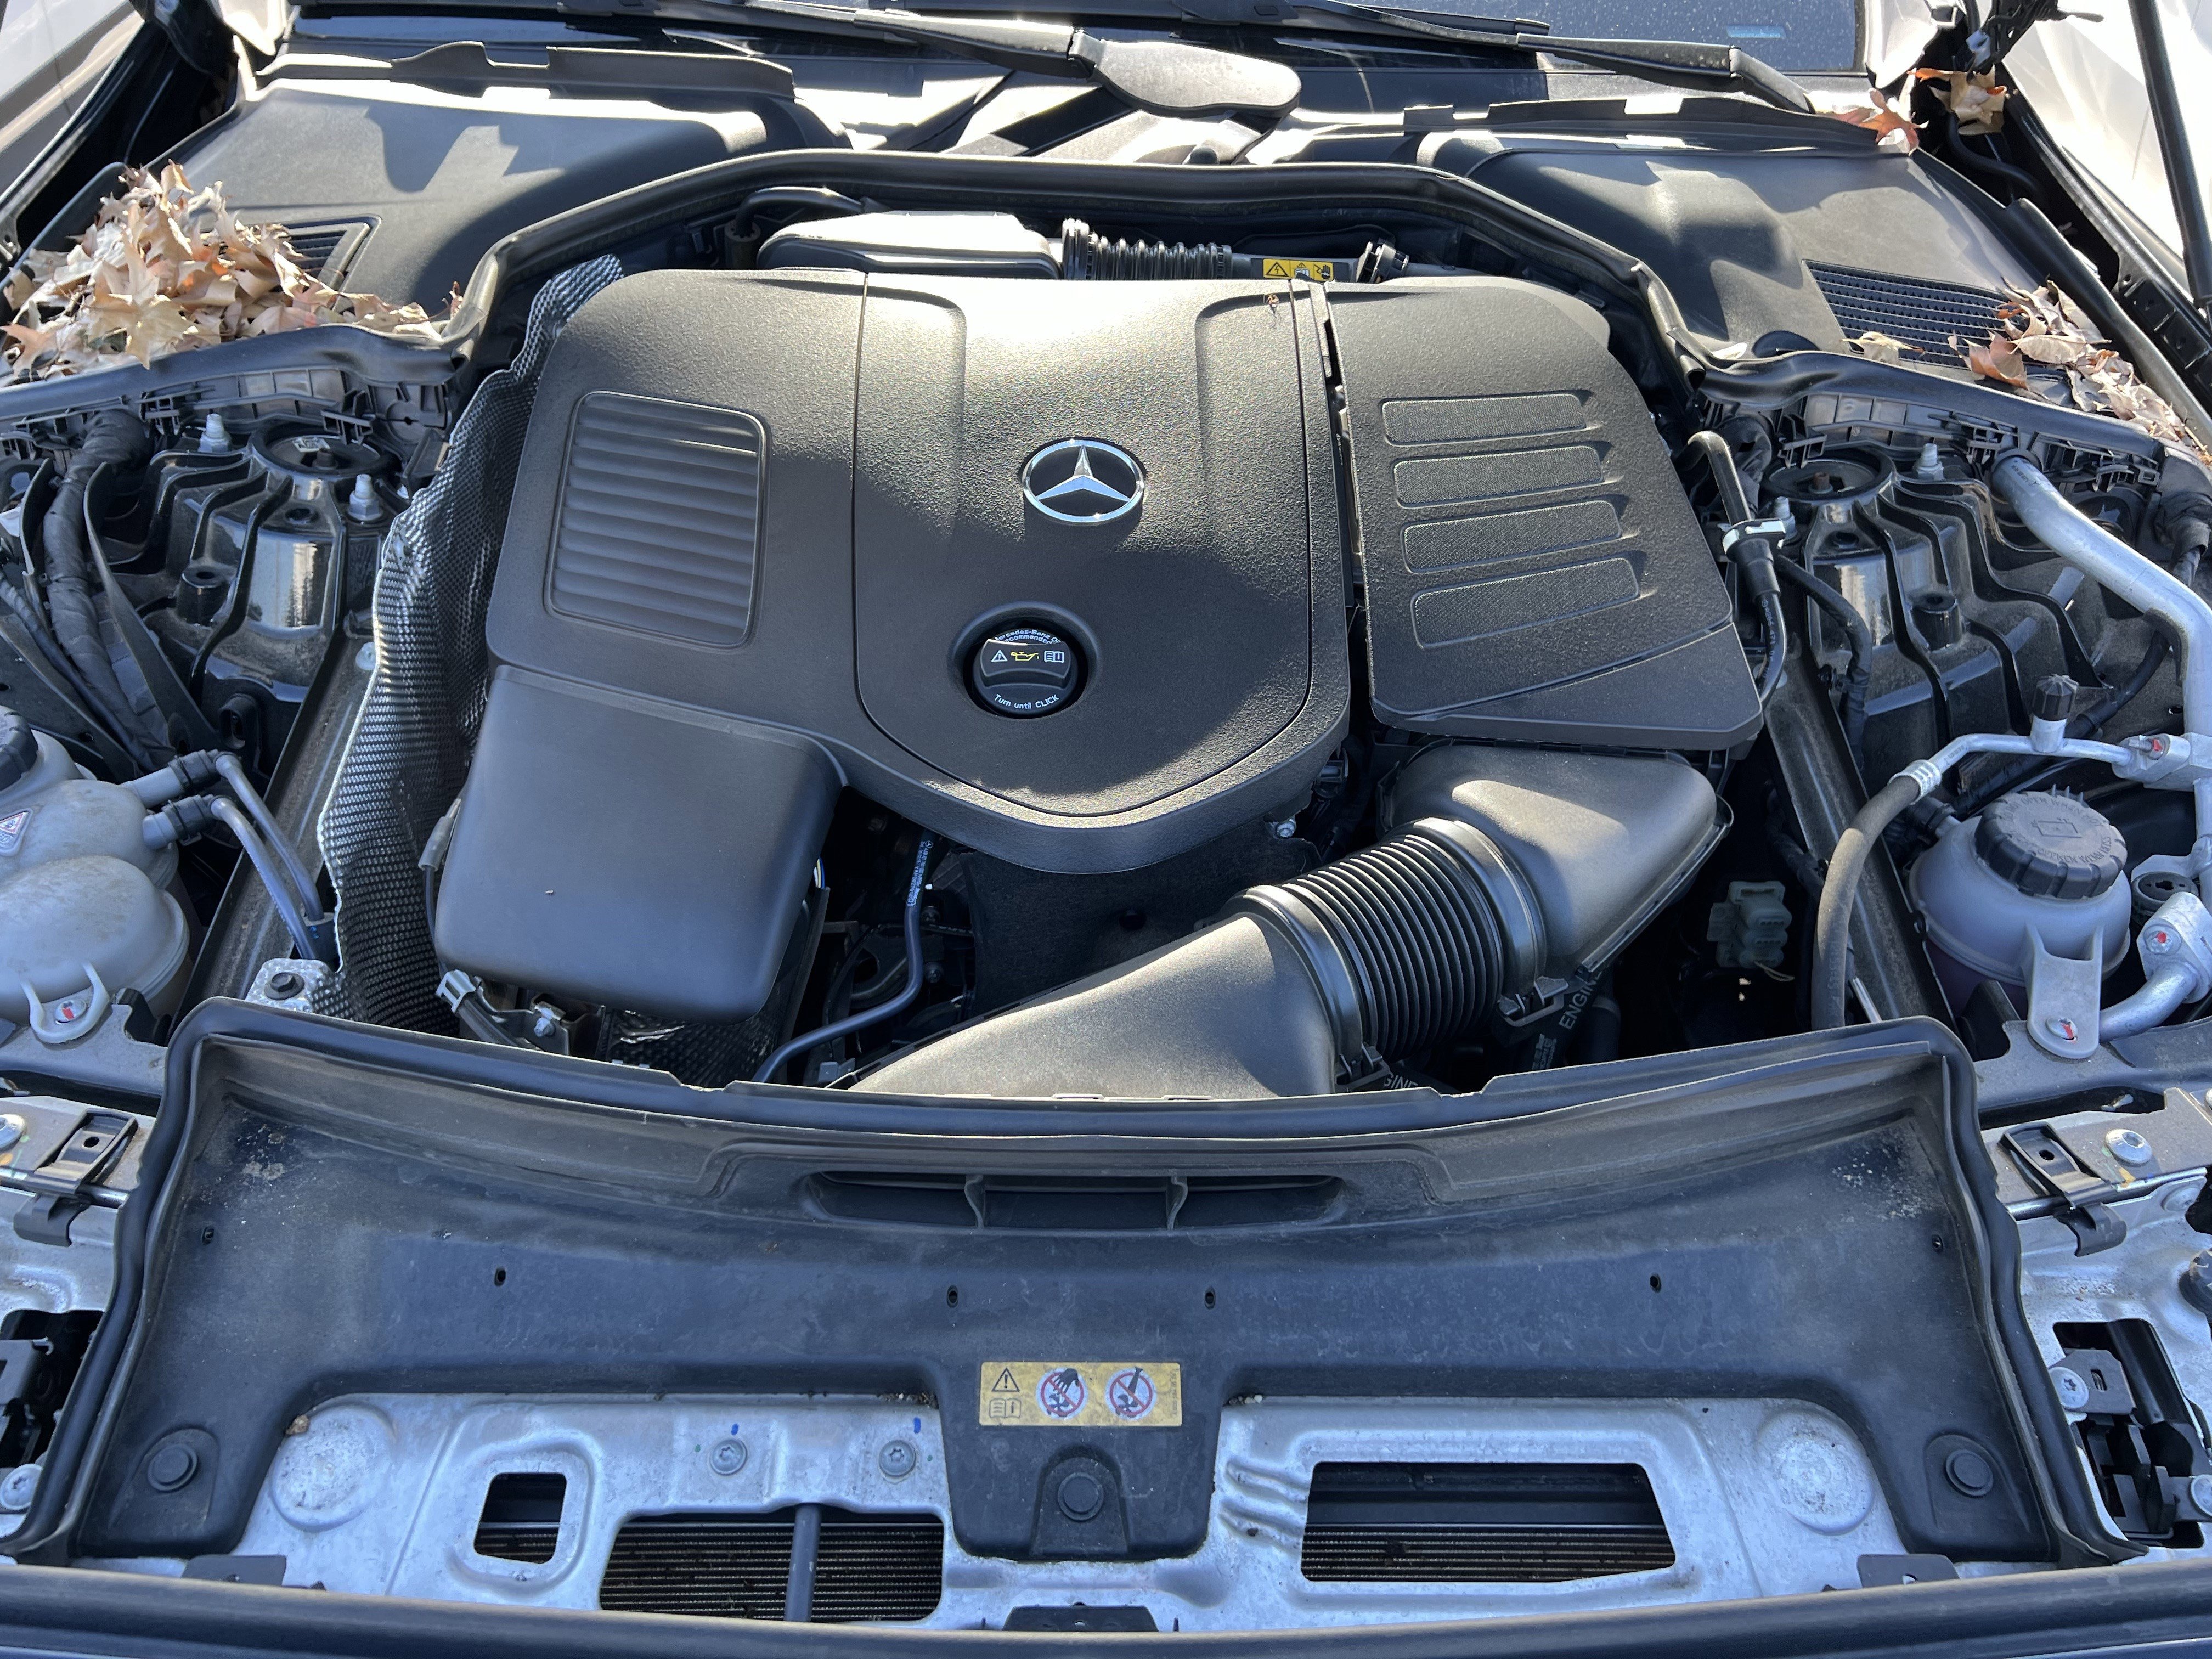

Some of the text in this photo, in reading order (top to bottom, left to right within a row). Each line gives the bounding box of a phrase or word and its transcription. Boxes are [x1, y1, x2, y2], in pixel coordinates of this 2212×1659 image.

[1005, 634, 1053, 644] ecommended
[994, 693, 1012, 707] Turn
[1035, 694, 1059, 708] CLICK
